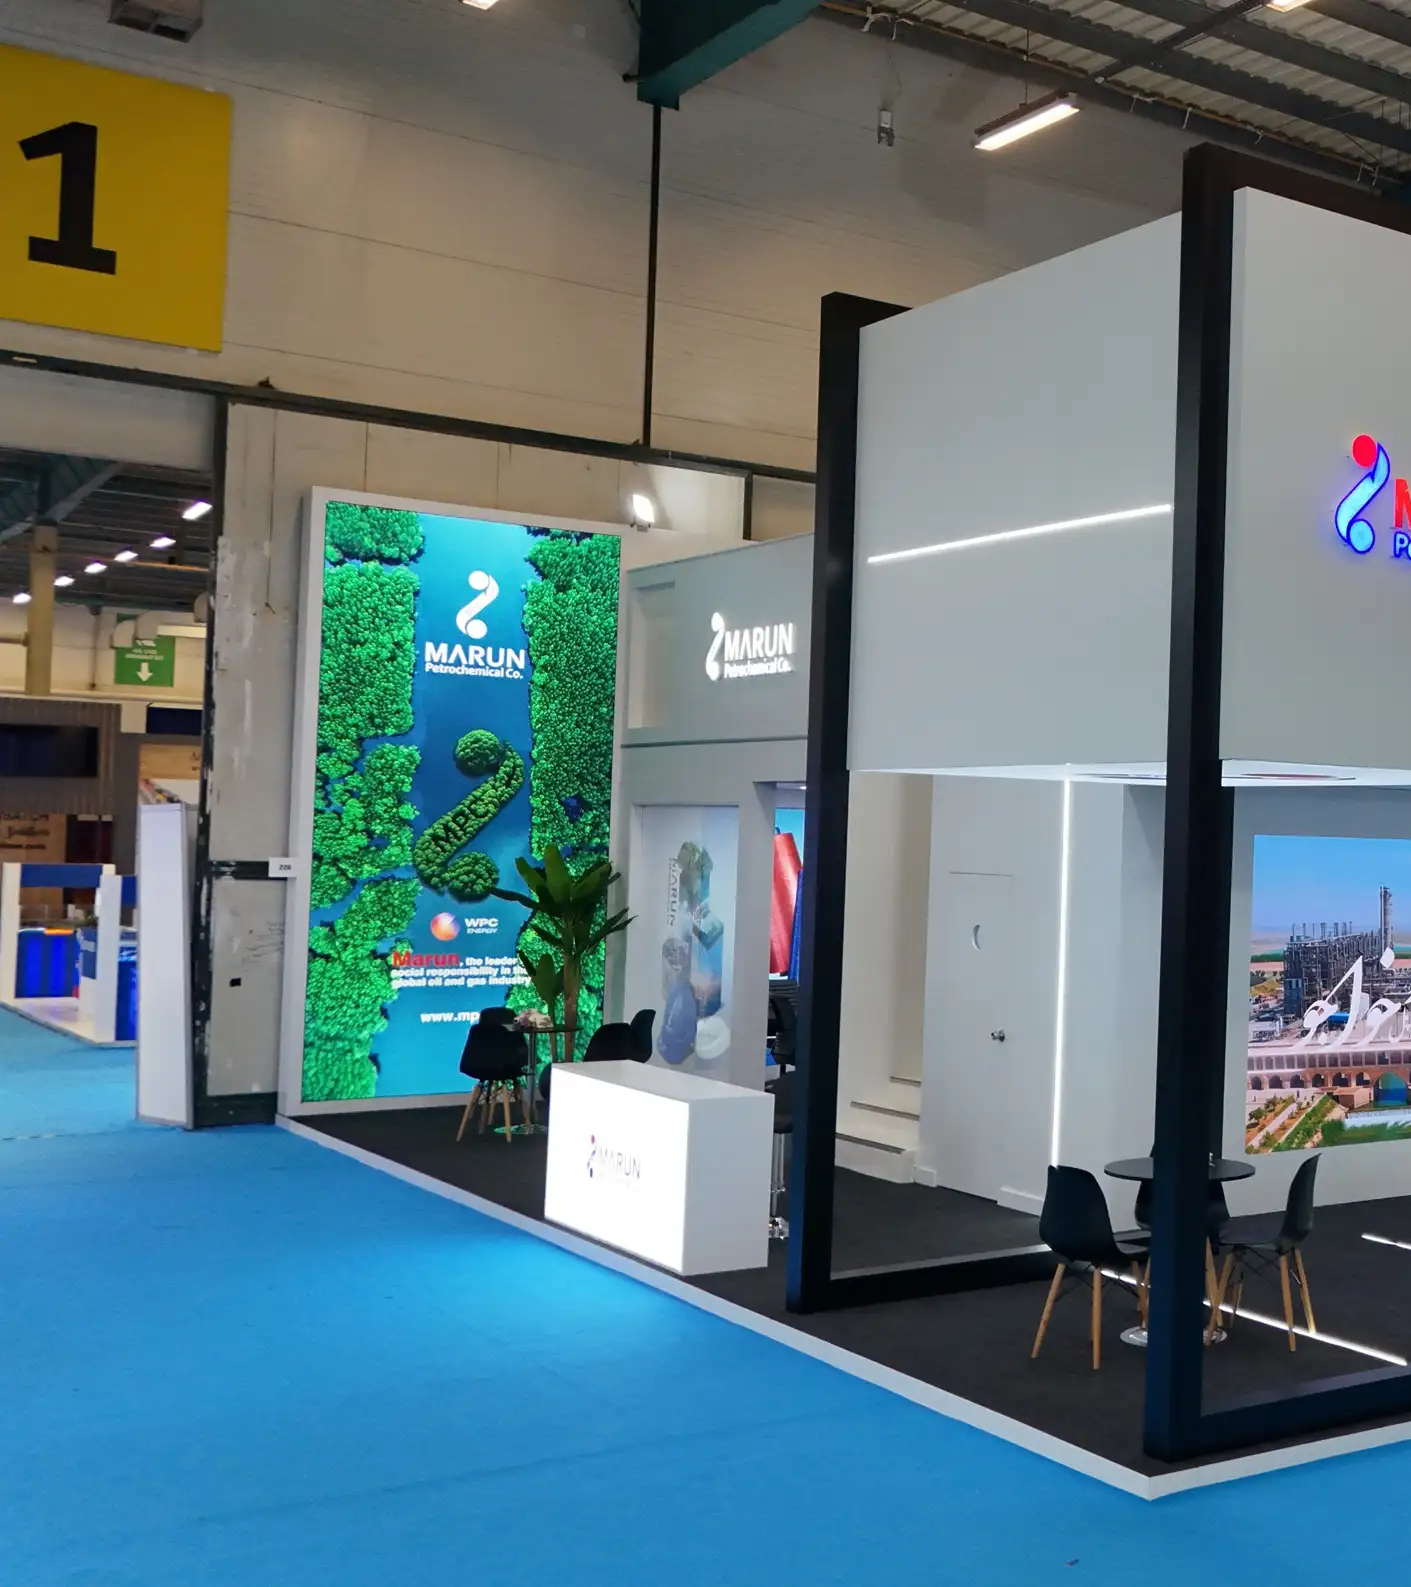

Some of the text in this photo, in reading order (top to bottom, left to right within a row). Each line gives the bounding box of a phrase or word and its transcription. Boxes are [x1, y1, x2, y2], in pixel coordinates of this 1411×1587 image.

[17, 121, 117, 275] 1
[724, 622, 794, 661] MARUN
[425, 641, 525, 669] MARUN
[425, 662, 524, 679] Petrochemical Co.
[723, 657, 777, 679] Petrochemical
[464, 917, 499, 928] WPC
[392, 951, 464, 968] Marun,
[466, 957, 483, 966] the
[485, 956, 517, 966] leader
[391, 967, 424, 978] social
[426, 966, 498, 981] responsibility
[500, 966, 511, 976] in
[392, 975, 532, 990] global oil and gas industry
[420, 1011, 481, 1024] www.mp
